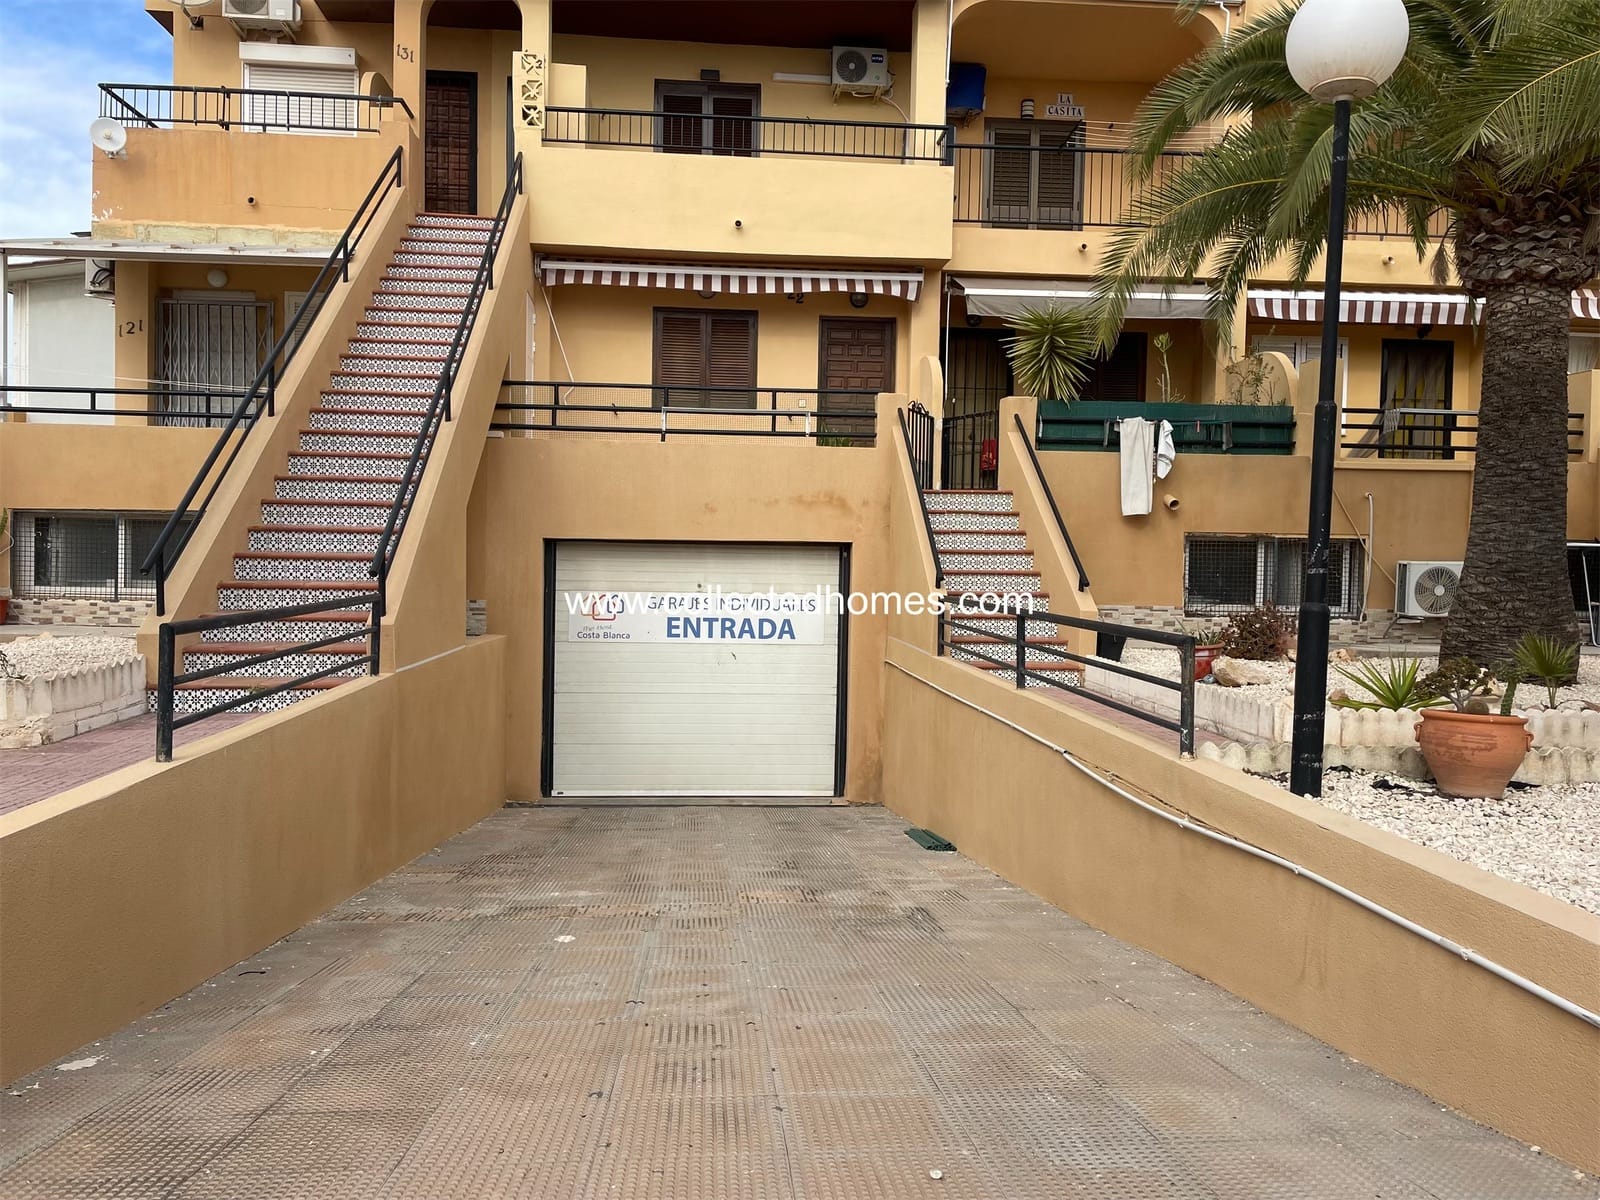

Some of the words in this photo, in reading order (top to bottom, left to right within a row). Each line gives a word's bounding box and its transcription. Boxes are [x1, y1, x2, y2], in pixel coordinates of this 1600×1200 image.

[396, 43, 414, 63] 131
[1059, 94, 1071, 104] LA
[1047, 106, 1082, 116] CASITA
[119, 319, 143, 338] 121
[665, 616, 796, 640] ENTRADA
[576, 631, 600, 639] Costa
[603, 631, 631, 640] Blanca
